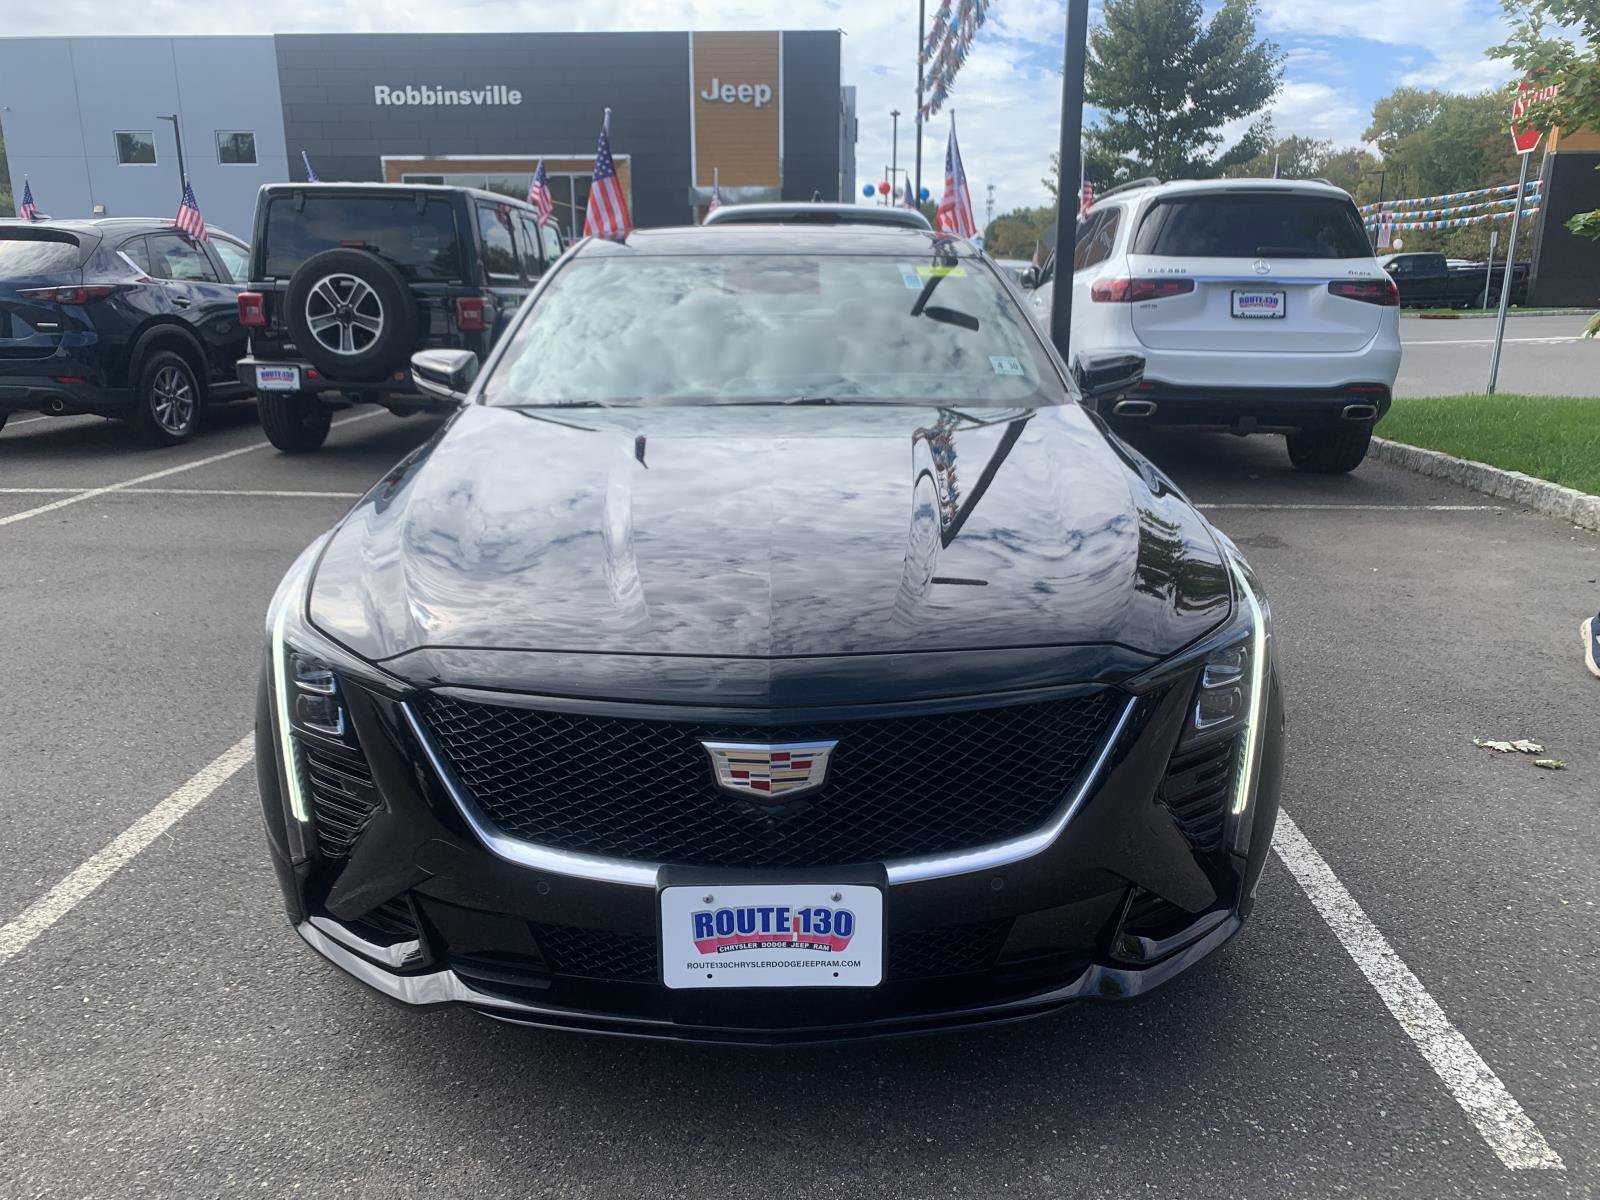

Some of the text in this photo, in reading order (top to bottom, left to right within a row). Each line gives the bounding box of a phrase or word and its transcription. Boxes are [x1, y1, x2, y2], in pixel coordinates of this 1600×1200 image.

[374, 85, 522, 105] Robbinsville
[701, 78, 772, 107] Jeep
[694, 907, 853, 939] ROUTE 130
[719, 943, 758, 953] CHRYSLER
[687, 960, 861, 969] ROUTE130CHRYSLERDODGEJEEPRAM.COM
